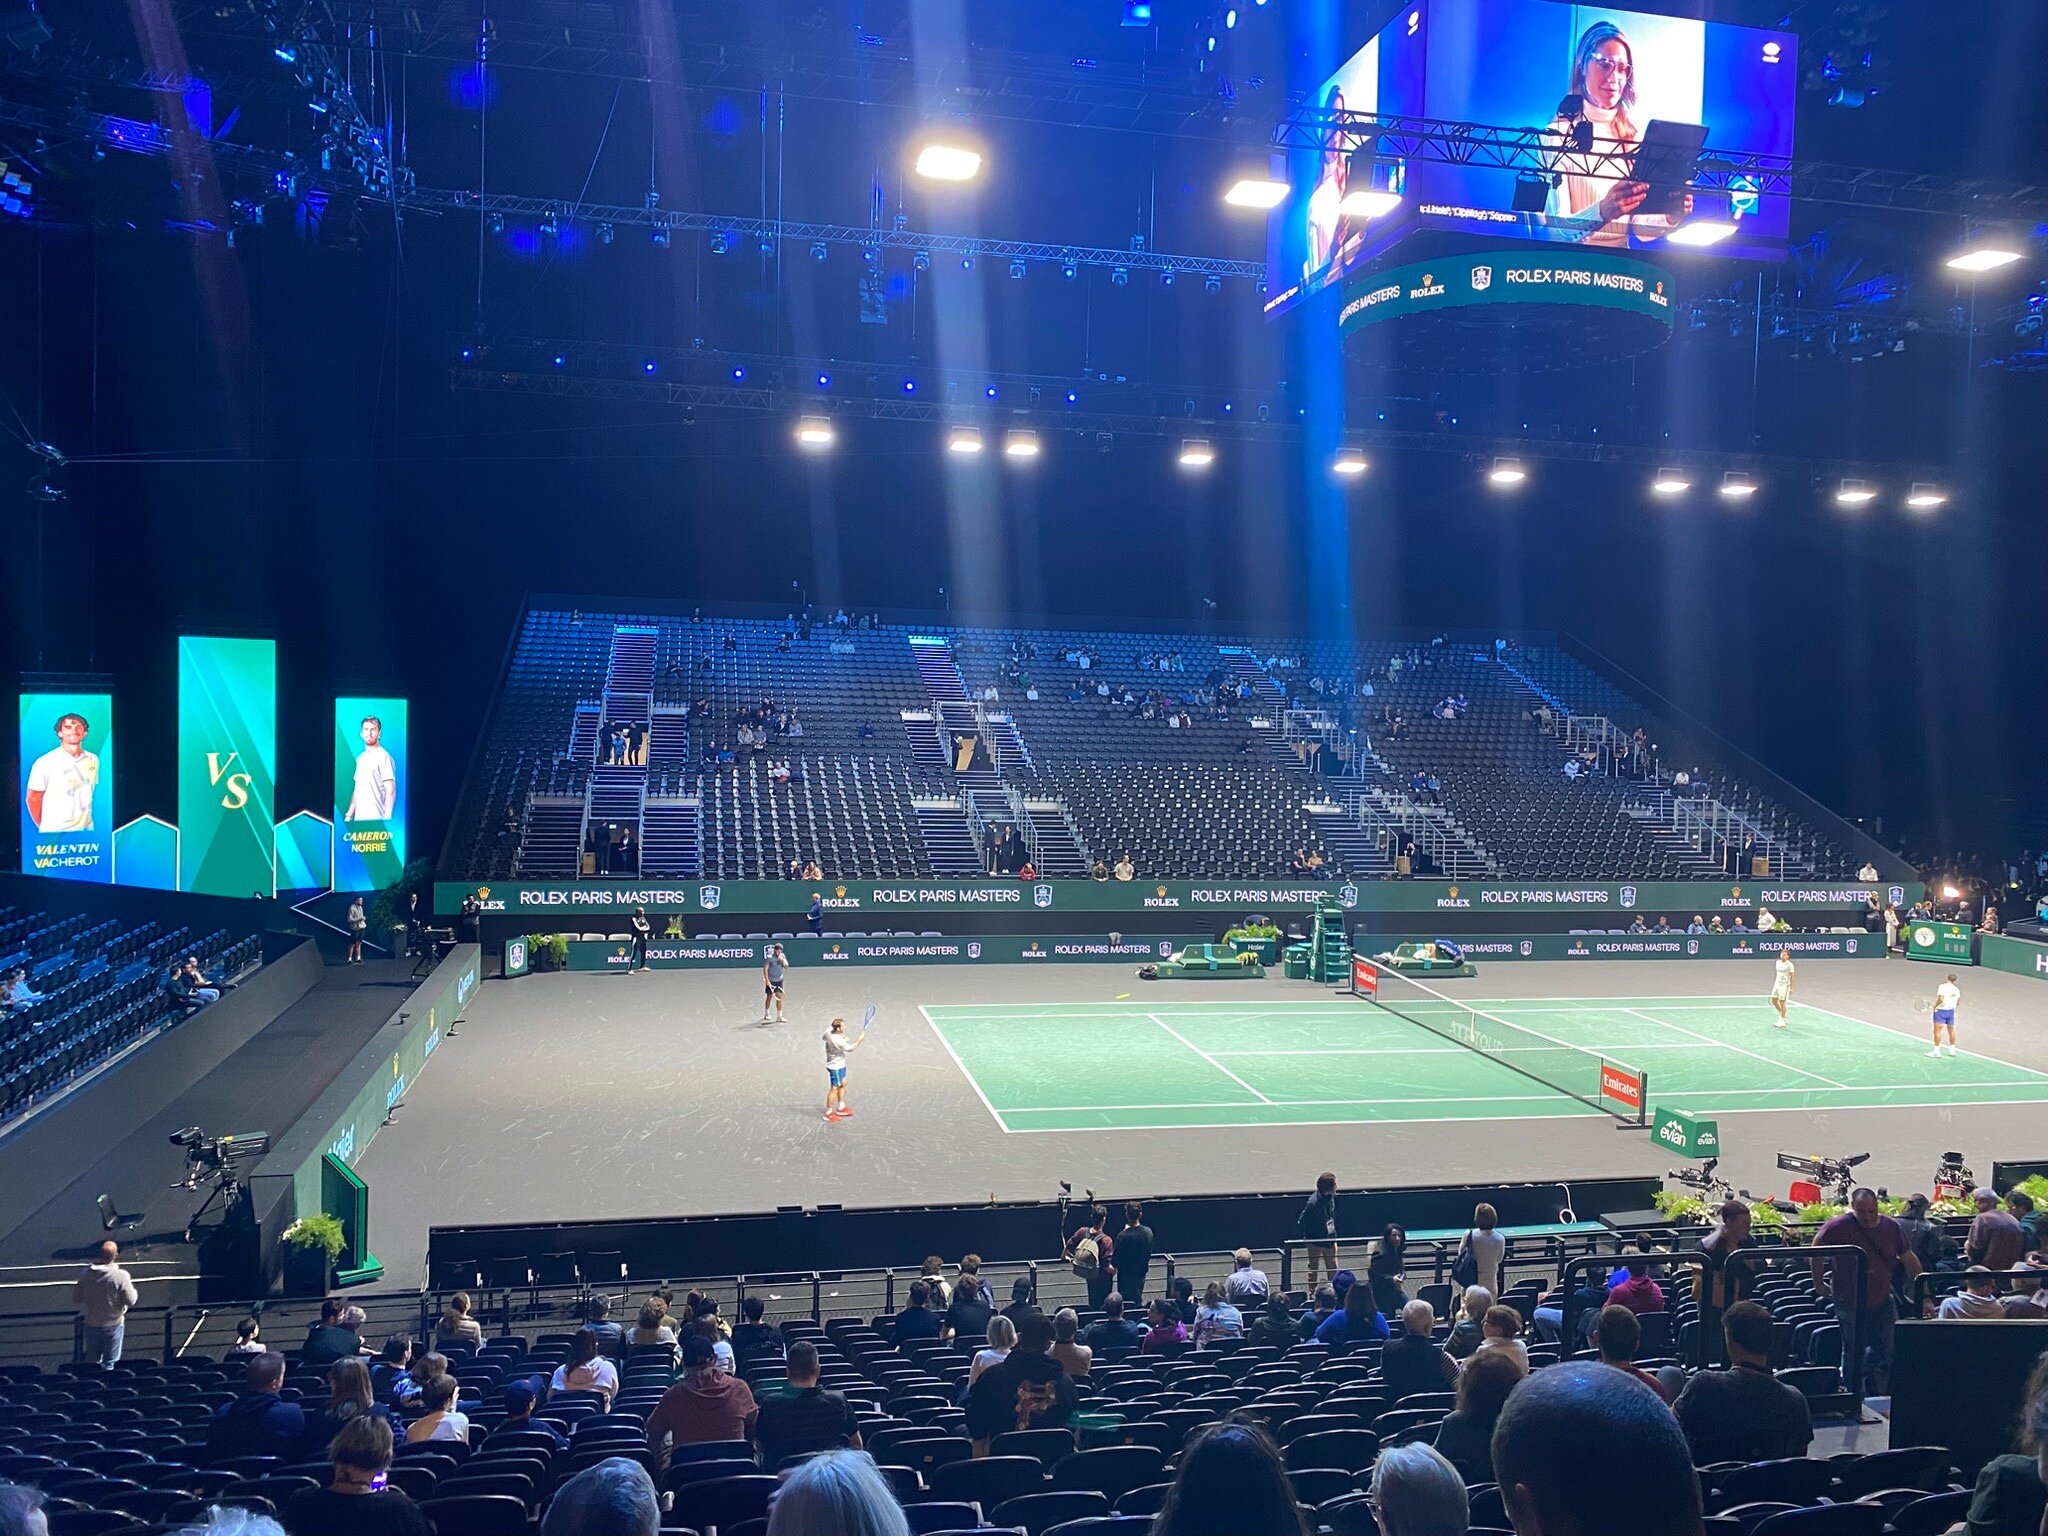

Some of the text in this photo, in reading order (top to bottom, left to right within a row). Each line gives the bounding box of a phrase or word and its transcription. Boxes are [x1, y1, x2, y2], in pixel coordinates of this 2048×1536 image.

[1506, 270, 1644, 293] ROLEX PARIS MASTERS
[1360, 285, 1400, 309] MASTERS
[1410, 284, 1445, 299] ROLEX
[1649, 292, 1668, 307] ROLEX
[343, 831, 393, 841] CAMERON
[36, 843, 100, 855] VALENTIN
[352, 843, 387, 852] NORRIE
[34, 856, 100, 868] VACHEROT
[520, 890, 684, 904] ROLEX PARIS MASTERS
[873, 889, 1020, 903] ROLEX PARIS MASTERS
[1191, 890, 1231, 902] ROLEX
[1234, 890, 1268, 902] PARIS
[1482, 890, 1608, 903] ROLEX PARIS MASTERS
[1762, 890, 1877, 902] ROLEX PARIS MASTER
[822, 899, 860, 907] ROLEX
[1144, 898, 1179, 907] ROLEX
[1437, 898, 1470, 907] ROLEX
[1721, 898, 1751, 907] ROLEX
[1943, 932, 1967, 940] ROLEX
[857, 946, 958, 956] ROLEX PARIS MASTERS
[1055, 945, 1150, 954] ROLEX PARIS MASTERS
[1456, 943, 1512, 953] ARIS MASTERS
[1597, 943, 1680, 952] ROLEX PARIS MASTERS
[1759, 942, 1839, 951] ROLEX PARIS MASTERS
[645, 948, 753, 959] ROLEX PARIS MASTERS
[1603, 1073, 1638, 1098] Emirates
[1660, 1126, 1687, 1147] evian
[1697, 1136, 1716, 1145] evian
